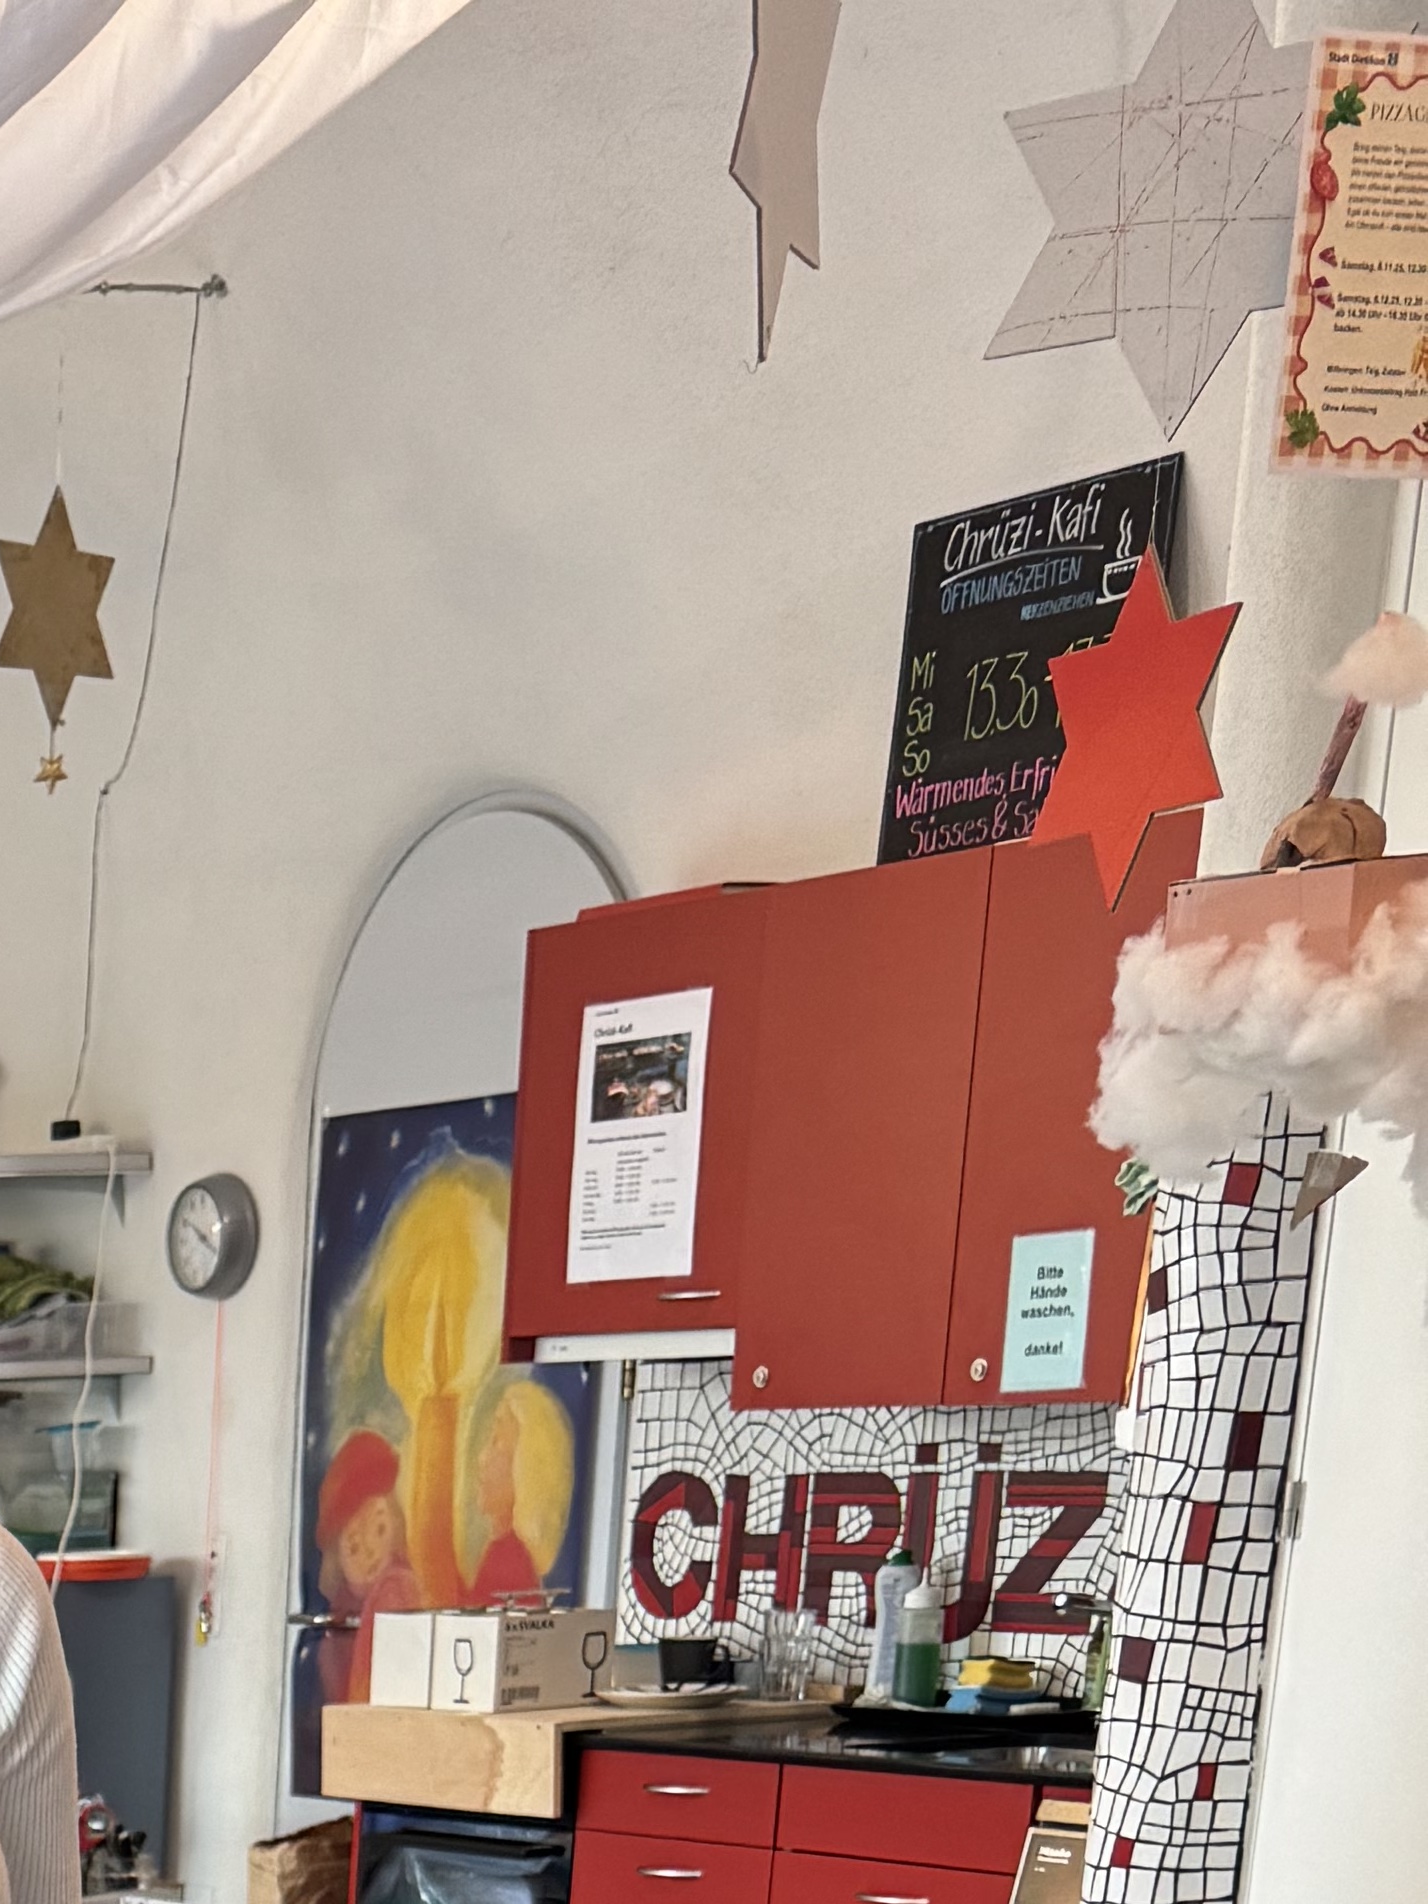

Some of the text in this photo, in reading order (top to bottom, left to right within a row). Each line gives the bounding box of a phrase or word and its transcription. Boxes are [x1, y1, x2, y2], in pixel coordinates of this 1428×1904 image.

[1370, 102, 1428, 122] PIZZAG
[910, 651, 938, 692] Mi
[906, 697, 934, 737] Sa
[902, 740, 931, 777] So
[1010, 754, 1058, 801] Erfri
[907, 815, 988, 858] Süsses
[1036, 1265, 1064, 1280] Bitte
[1030, 1284, 1068, 1300] Hände
